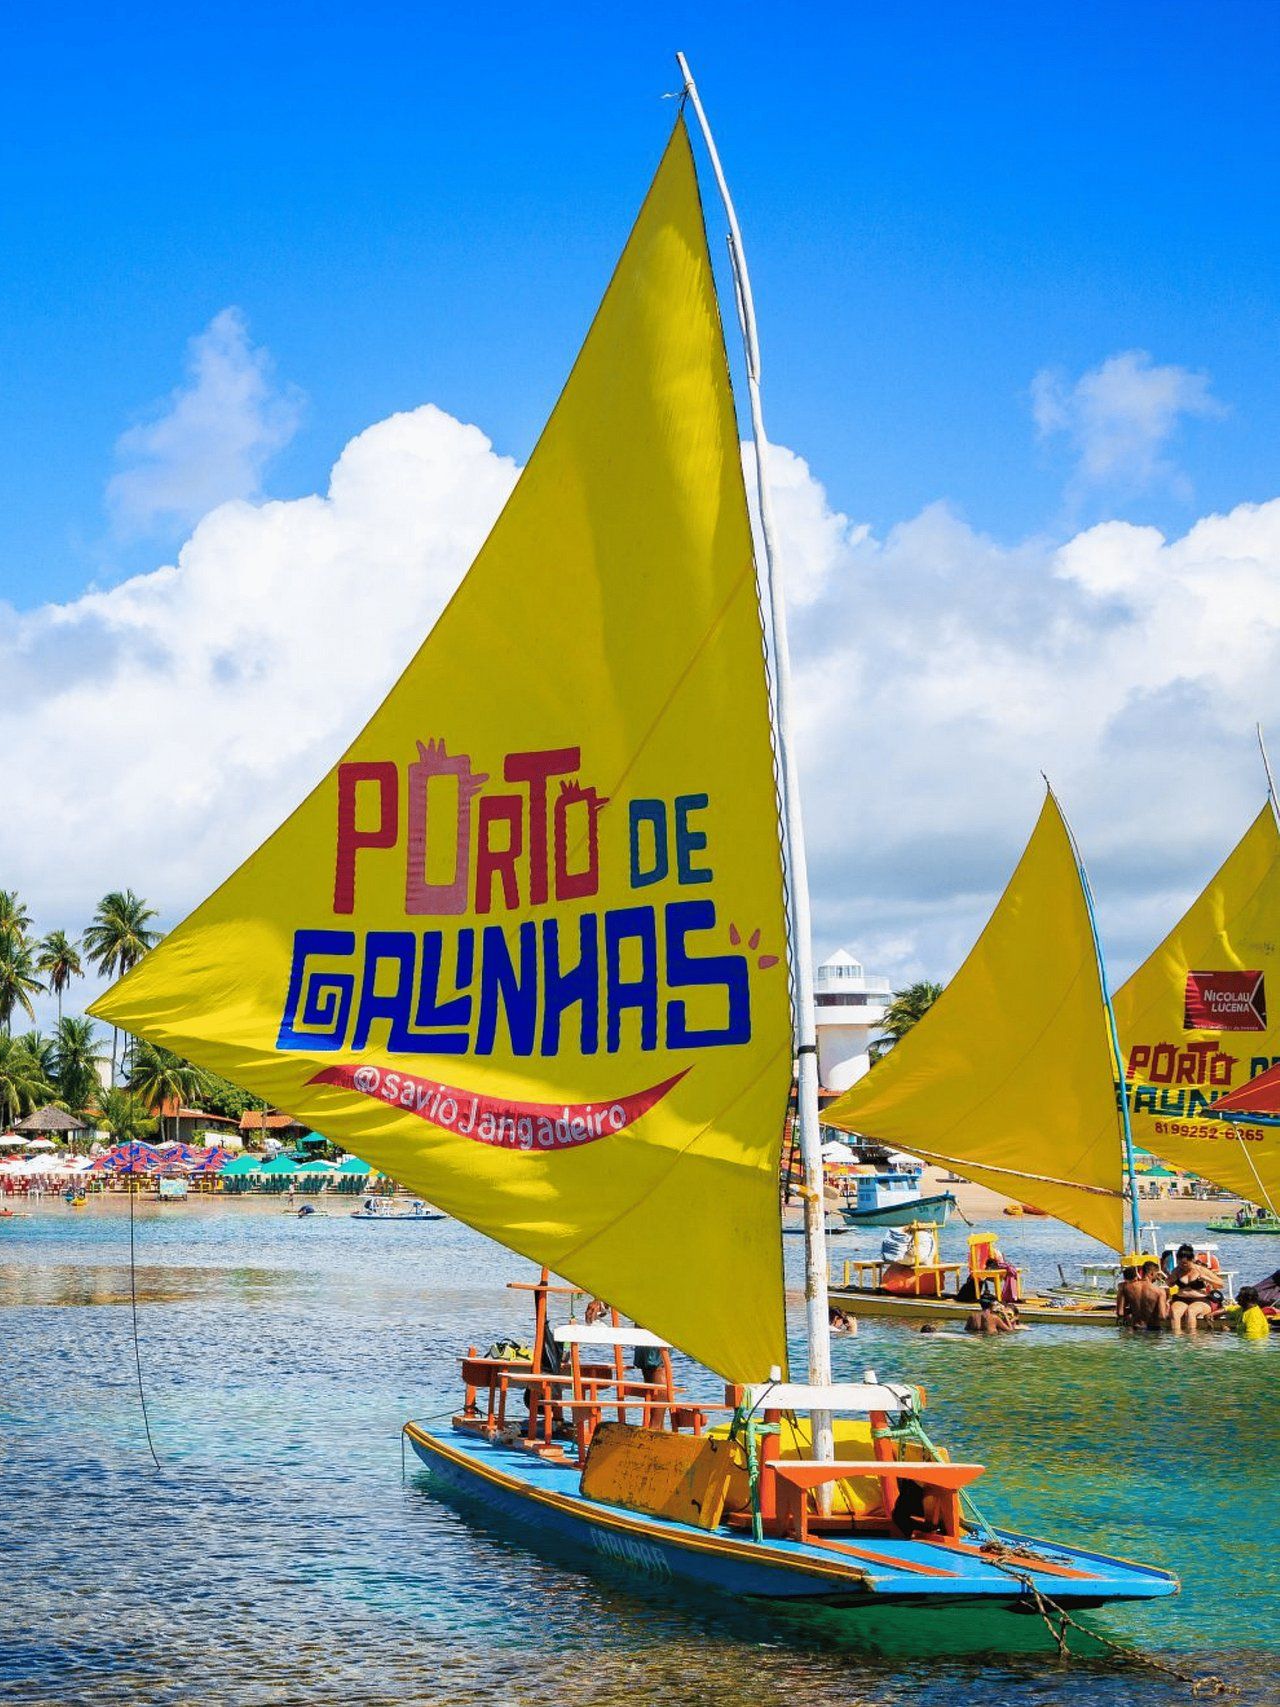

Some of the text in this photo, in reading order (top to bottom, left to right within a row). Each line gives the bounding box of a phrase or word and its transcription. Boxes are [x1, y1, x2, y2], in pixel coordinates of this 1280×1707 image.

[333, 738, 714, 915] PORTO DE
[275, 900, 751, 1056] GALINHAS
[1211, 1003, 1250, 1013] LUCENA
[1250, 1057, 1280, 1079] D
